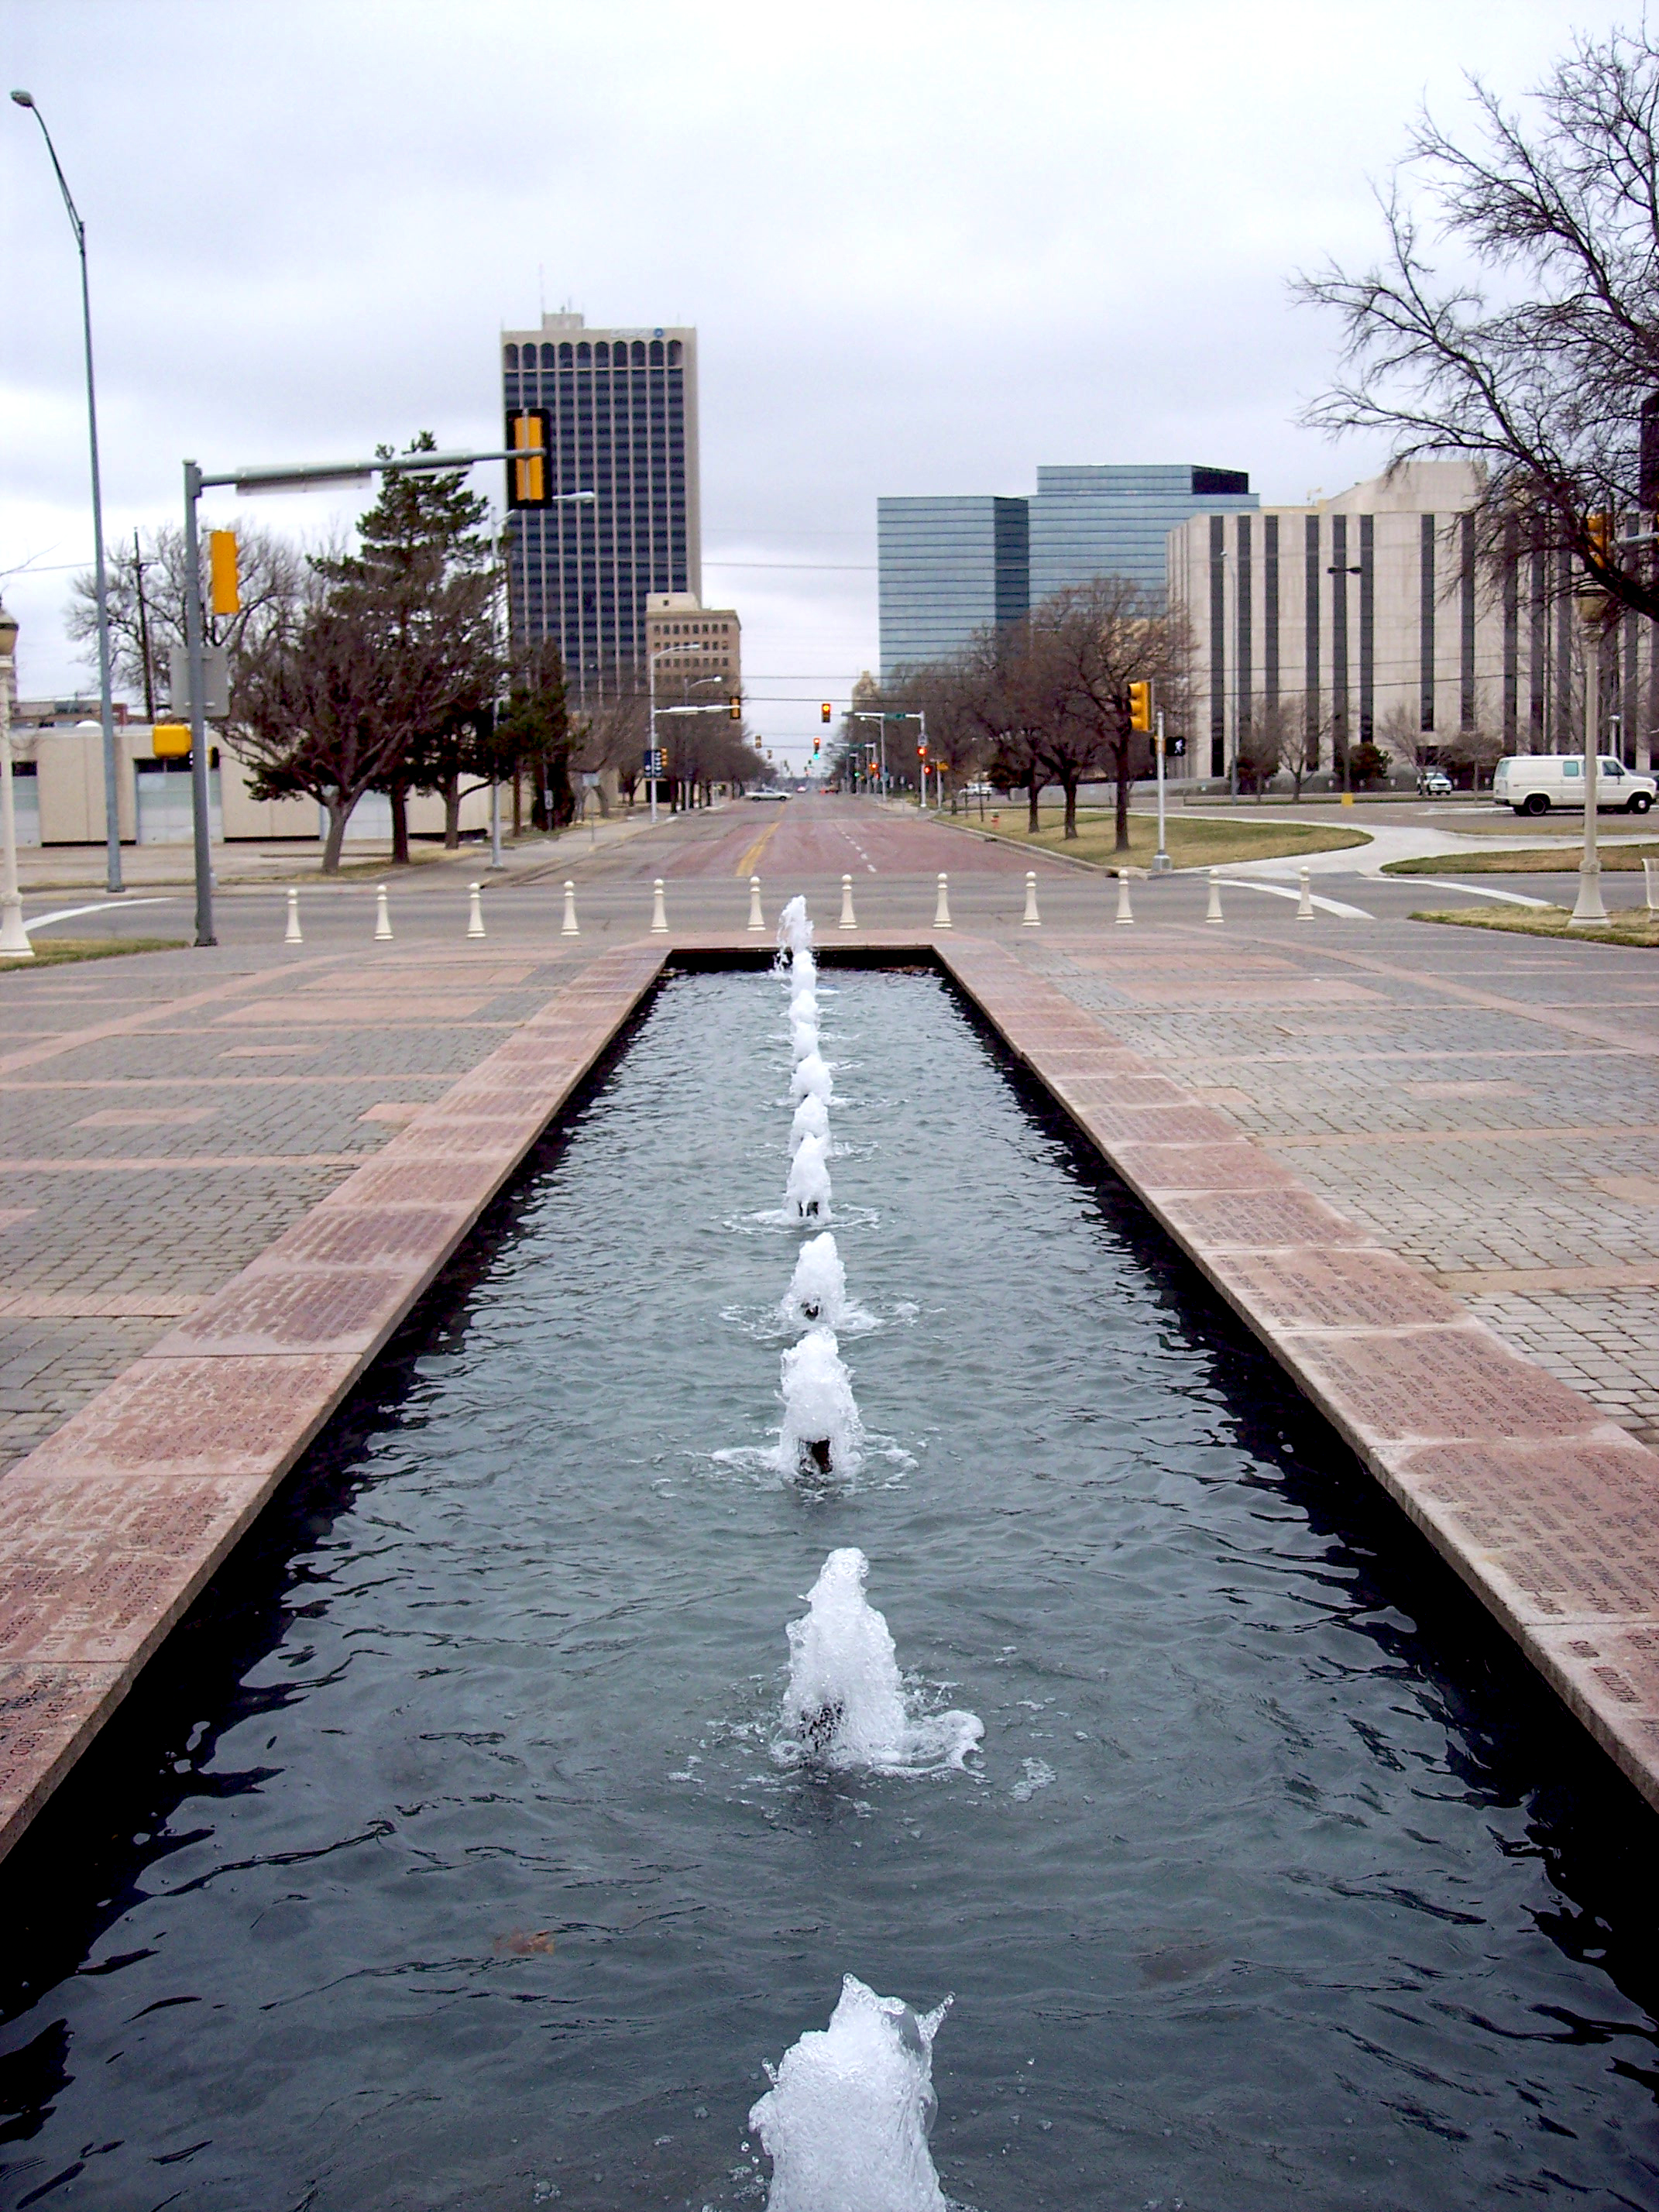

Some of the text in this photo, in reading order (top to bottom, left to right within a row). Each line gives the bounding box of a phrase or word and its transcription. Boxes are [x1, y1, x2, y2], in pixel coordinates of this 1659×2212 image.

[1621, 1633, 1659, 1649] FOR
[1565, 1639, 1645, 1703] AUCTION WAS
[5, 1732, 46, 1756] FOOD
